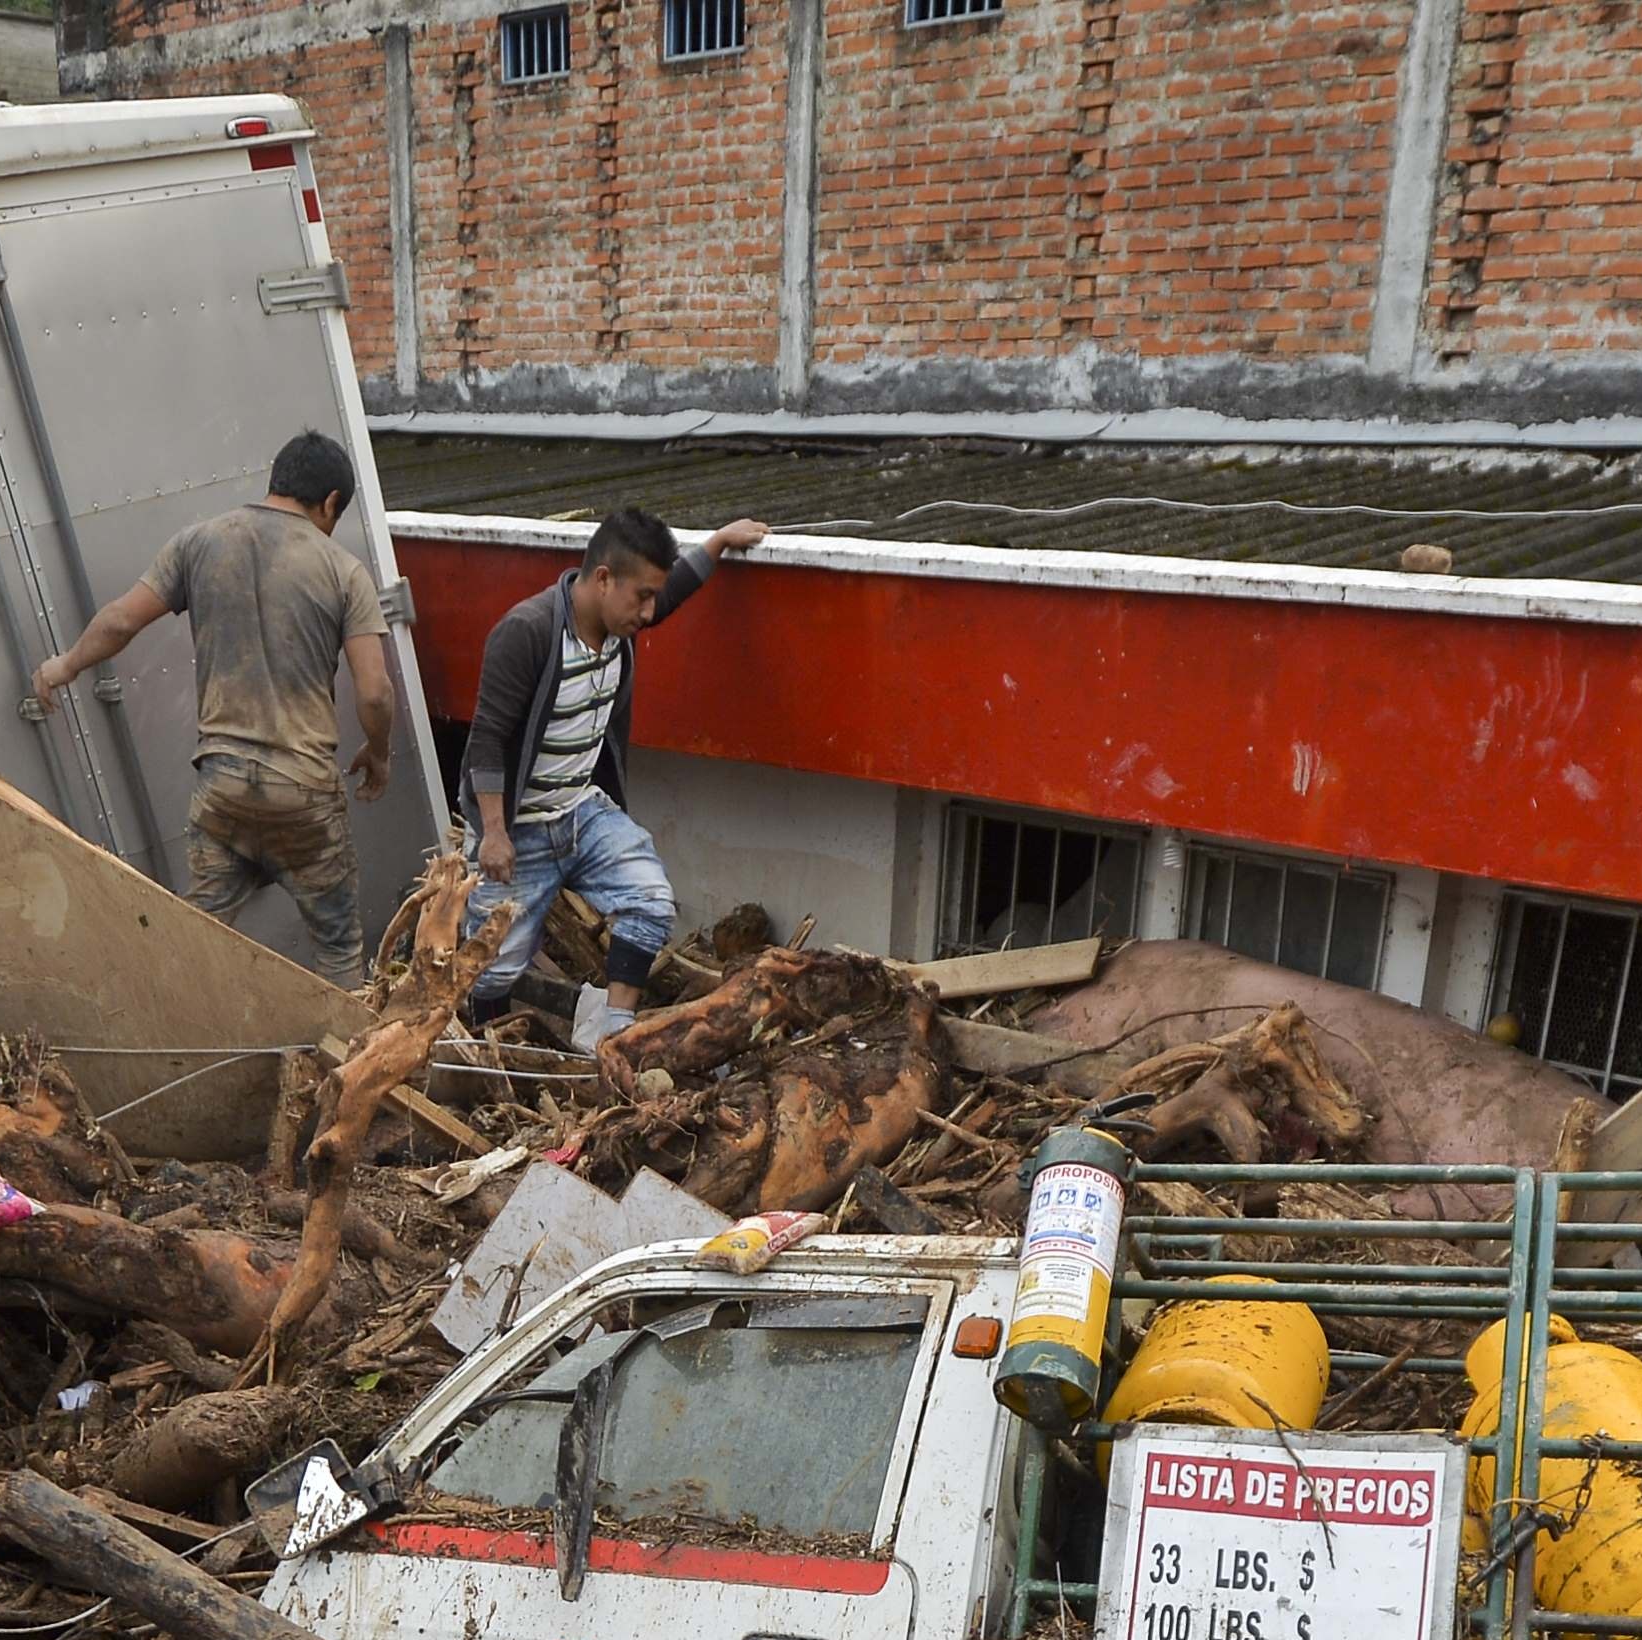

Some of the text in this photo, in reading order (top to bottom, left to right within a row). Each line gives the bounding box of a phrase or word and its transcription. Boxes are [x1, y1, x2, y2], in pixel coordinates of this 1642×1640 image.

[1149, 1461, 1430, 1518] LISTA DE PRECIOS
[1149, 1543, 1316, 1595] 33 LBS. $
